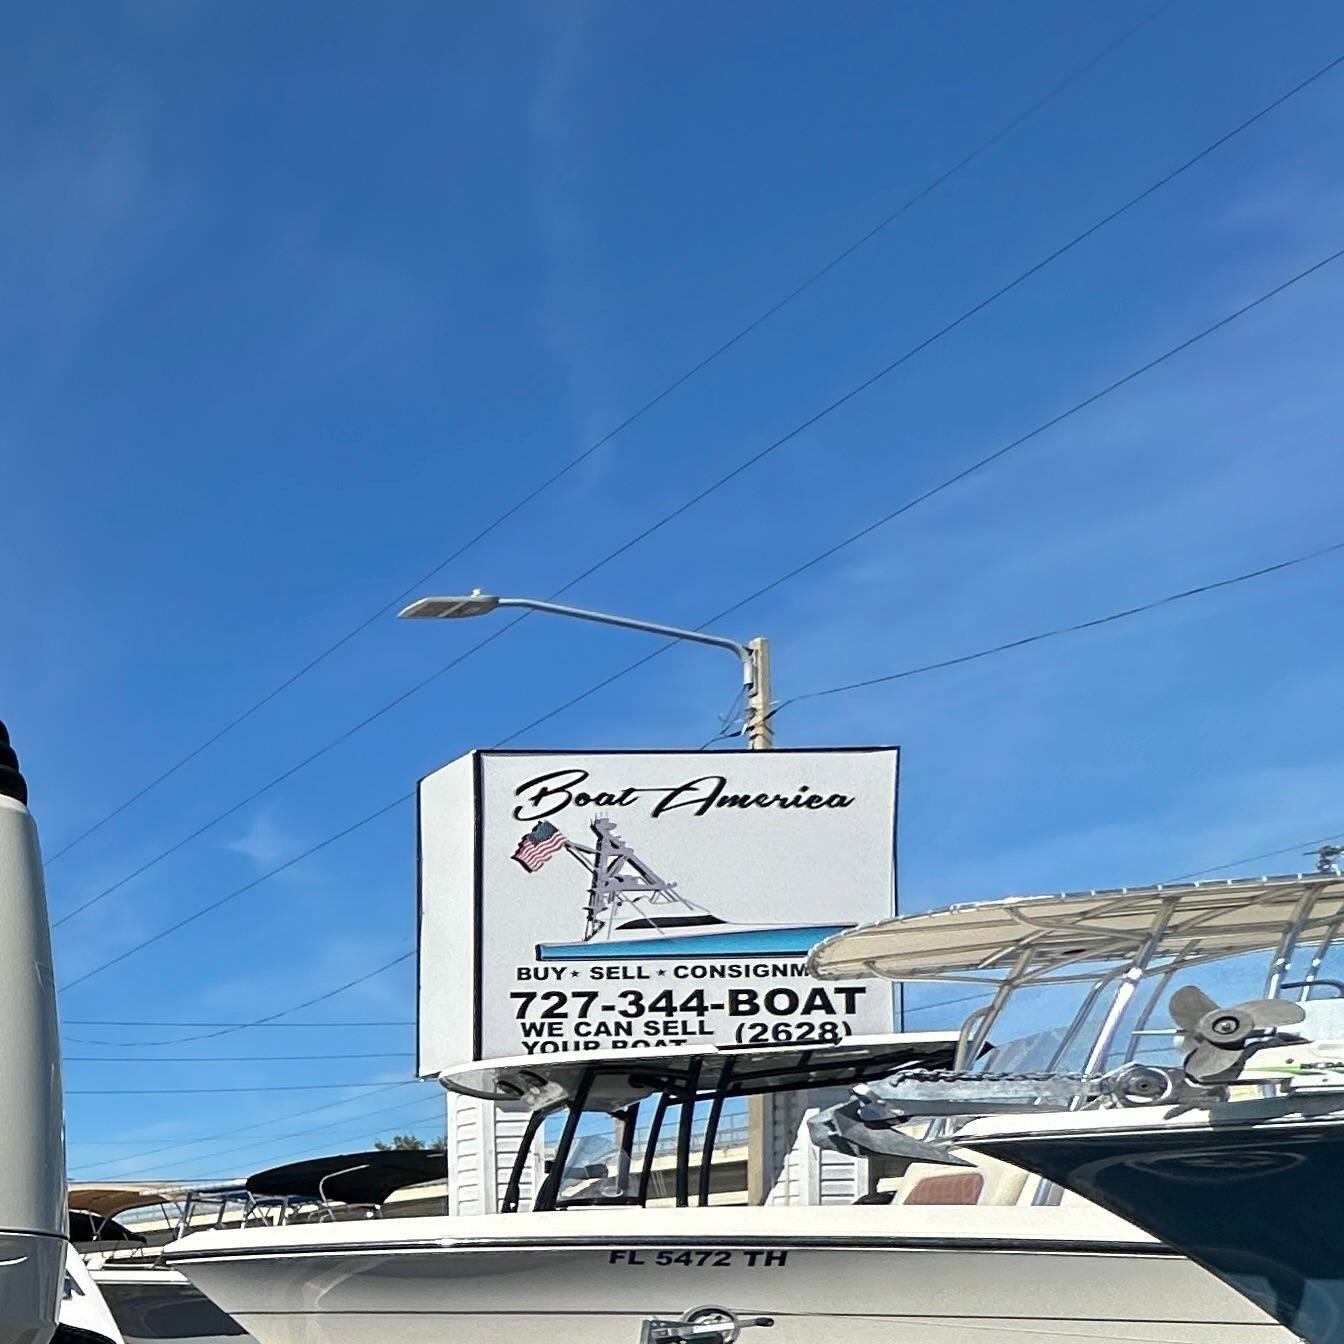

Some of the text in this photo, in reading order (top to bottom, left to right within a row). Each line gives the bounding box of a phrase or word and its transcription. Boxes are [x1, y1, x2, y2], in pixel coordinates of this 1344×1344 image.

[513, 769, 855, 821] Boat America
[517, 963, 809, 981] BUY SELL CONSIGNM
[510, 986, 867, 1020] 727-344-BOAT
[521, 1020, 715, 1037] WE CAN SELL
[735, 1020, 852, 1043] (2628)
[609, 1250, 789, 1267] FL 5472 TH
